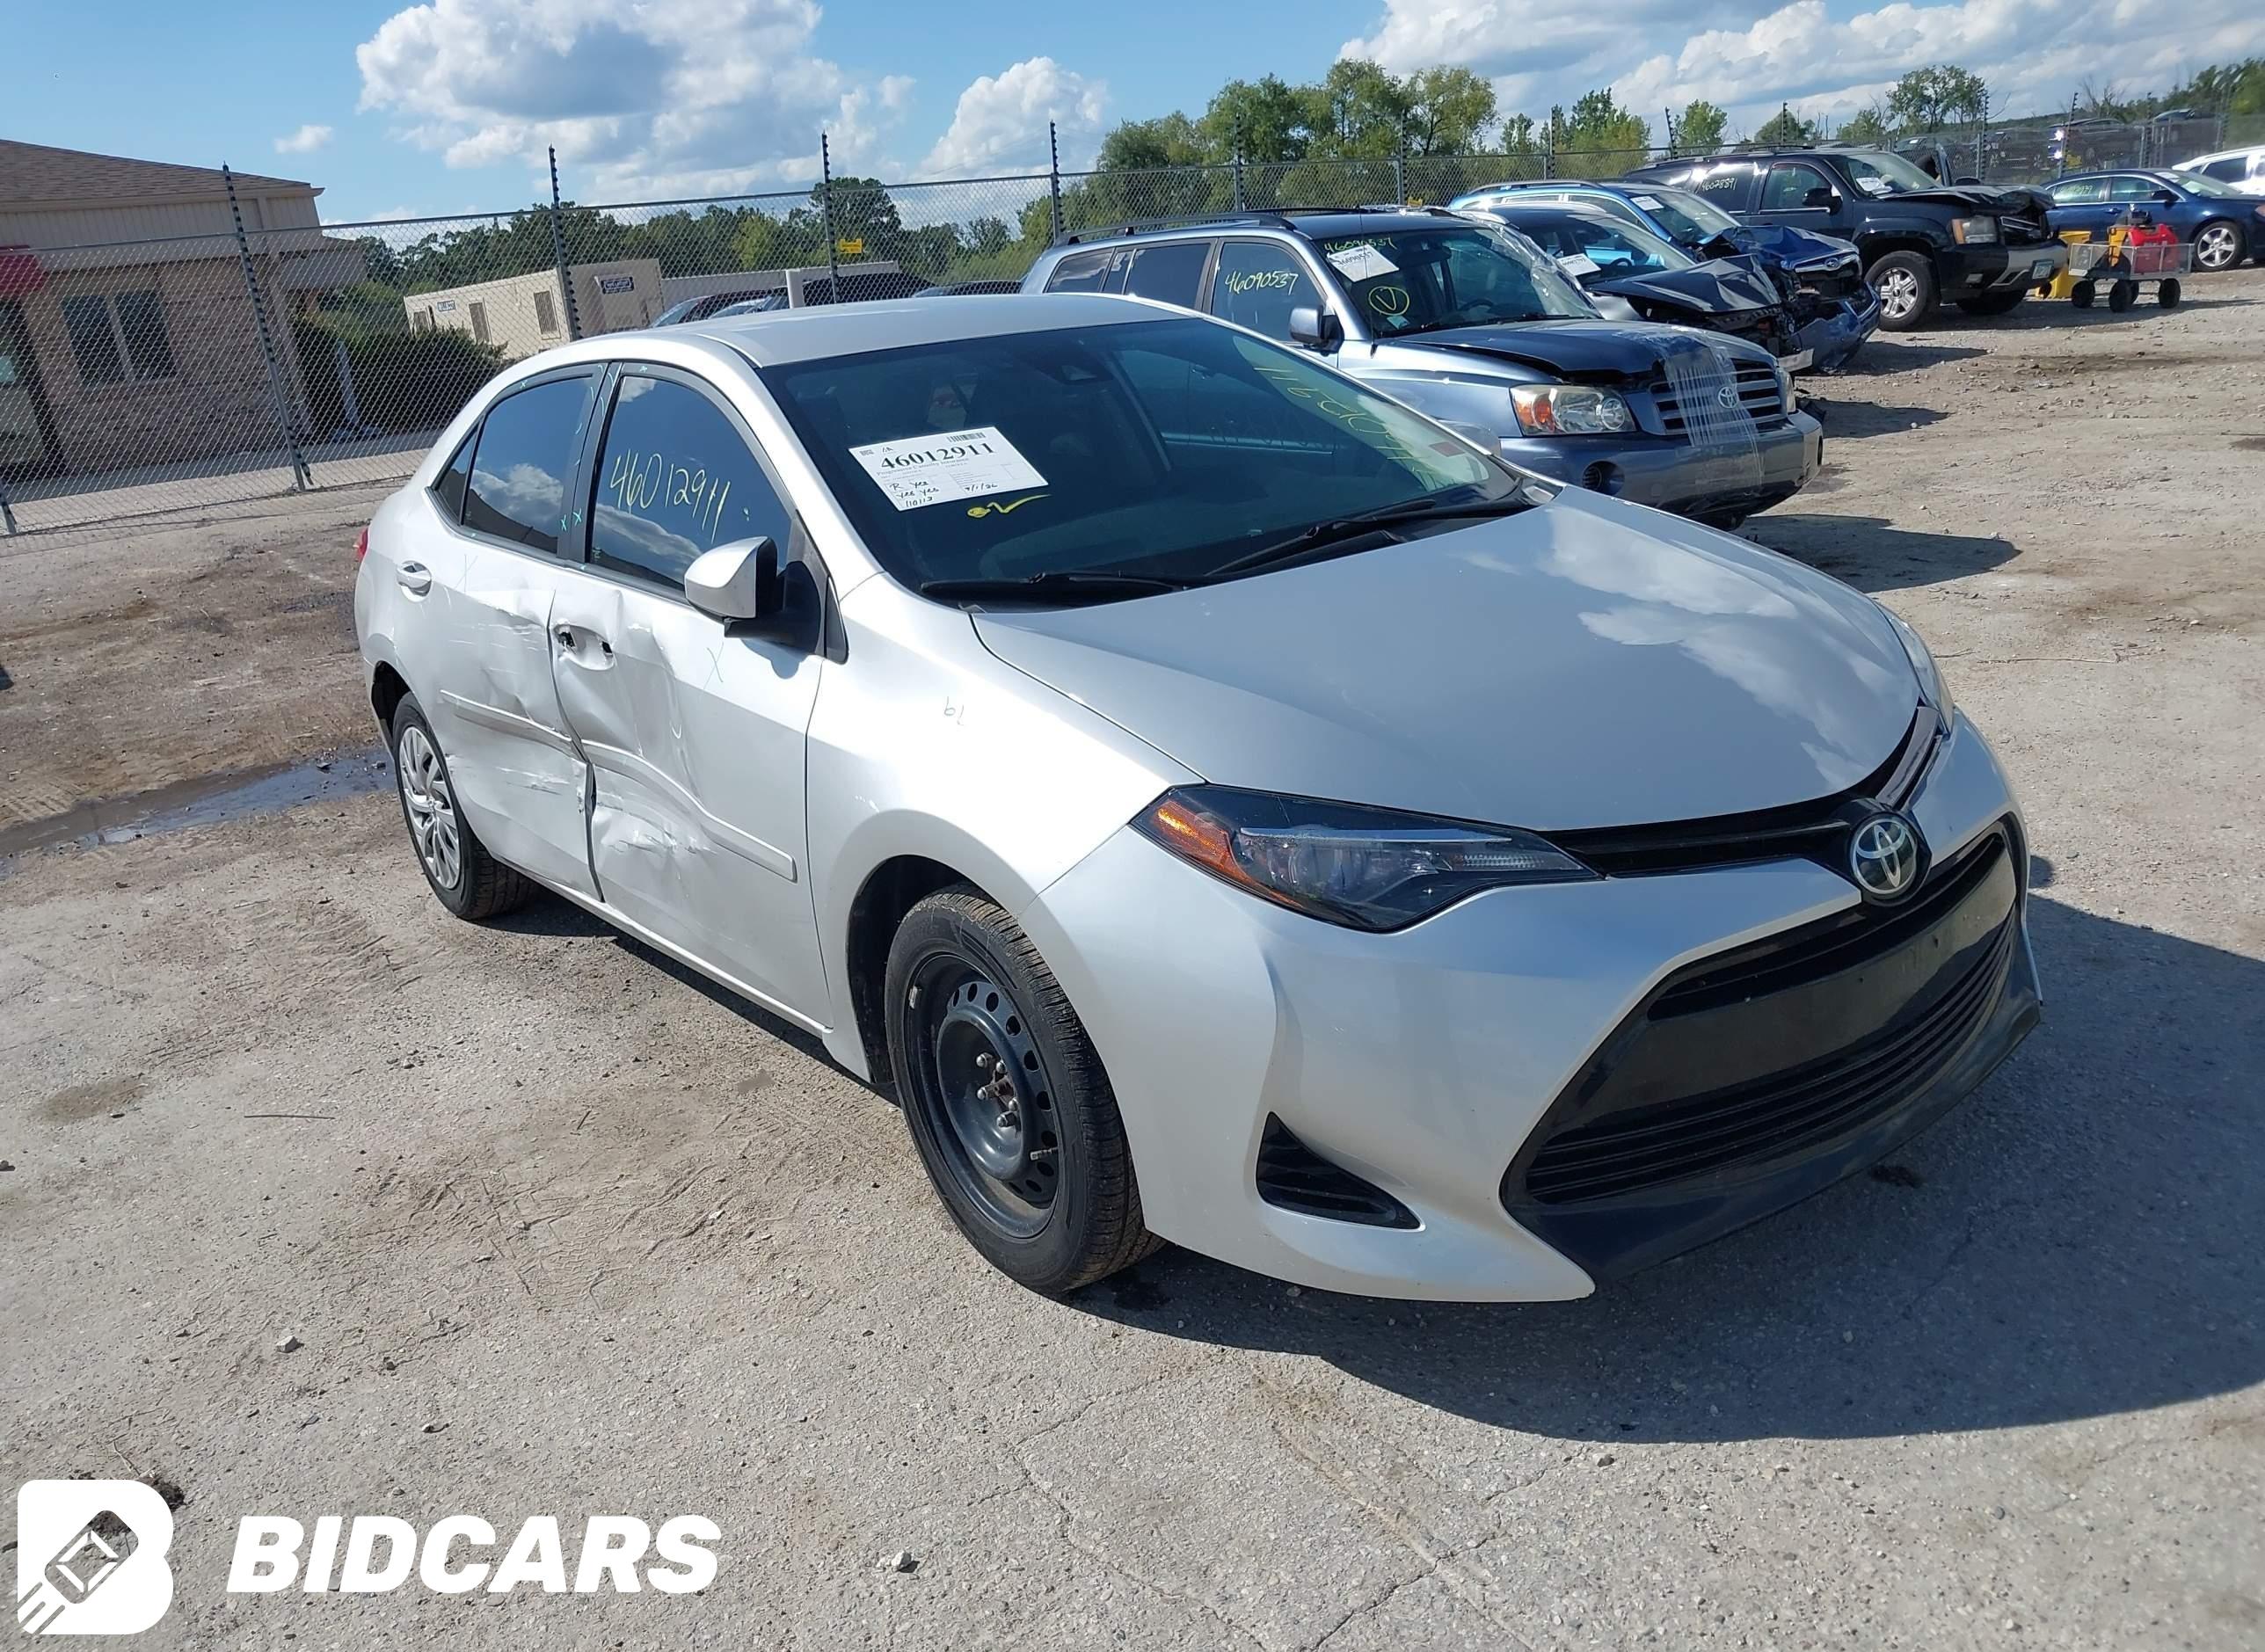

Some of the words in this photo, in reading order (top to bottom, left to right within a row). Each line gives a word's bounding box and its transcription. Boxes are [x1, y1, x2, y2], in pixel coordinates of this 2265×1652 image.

[1225, 270, 1299, 295] 46090537
[881, 442, 995, 469] 46012911
[609, 449, 731, 544] 46012911
